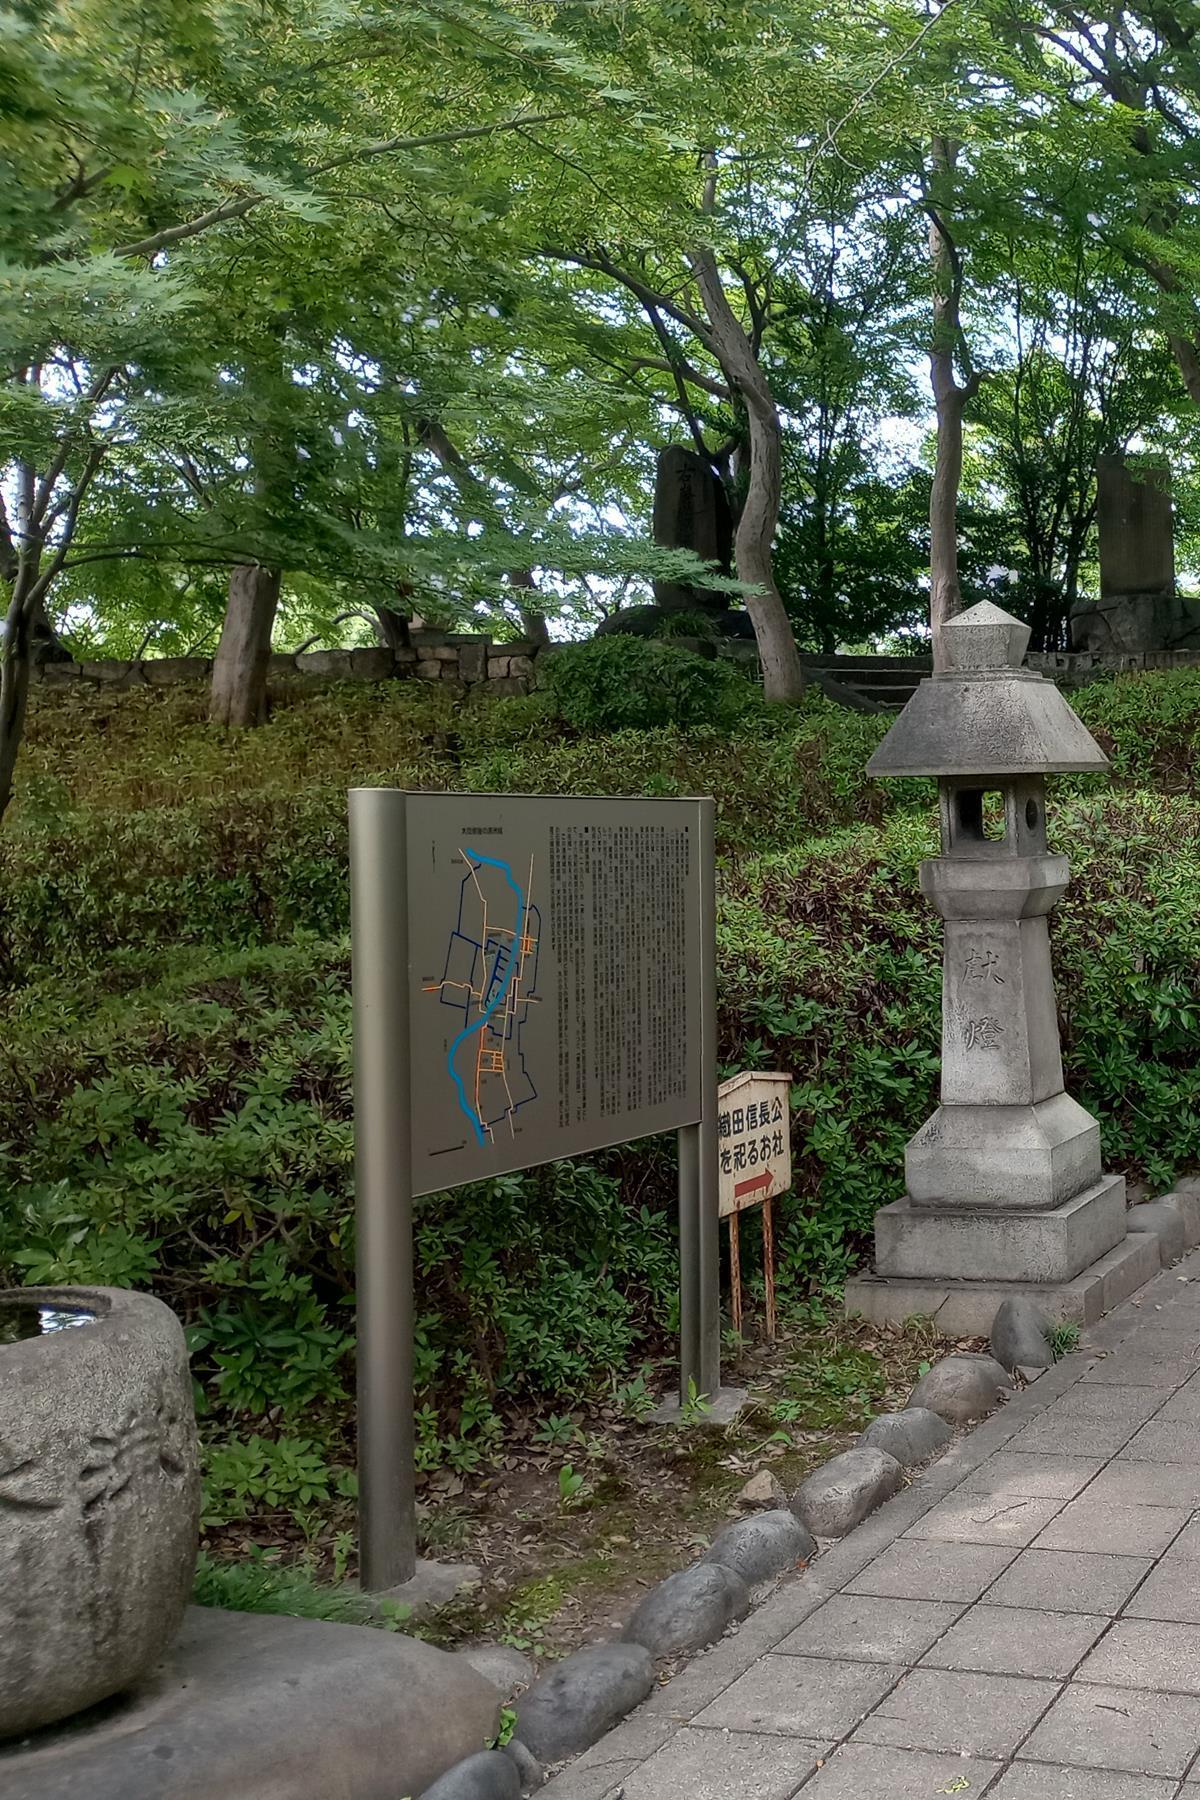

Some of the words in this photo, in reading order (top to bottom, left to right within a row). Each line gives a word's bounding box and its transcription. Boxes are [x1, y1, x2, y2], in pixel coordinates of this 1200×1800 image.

[720, 1129, 784, 1174] を祀るお社
